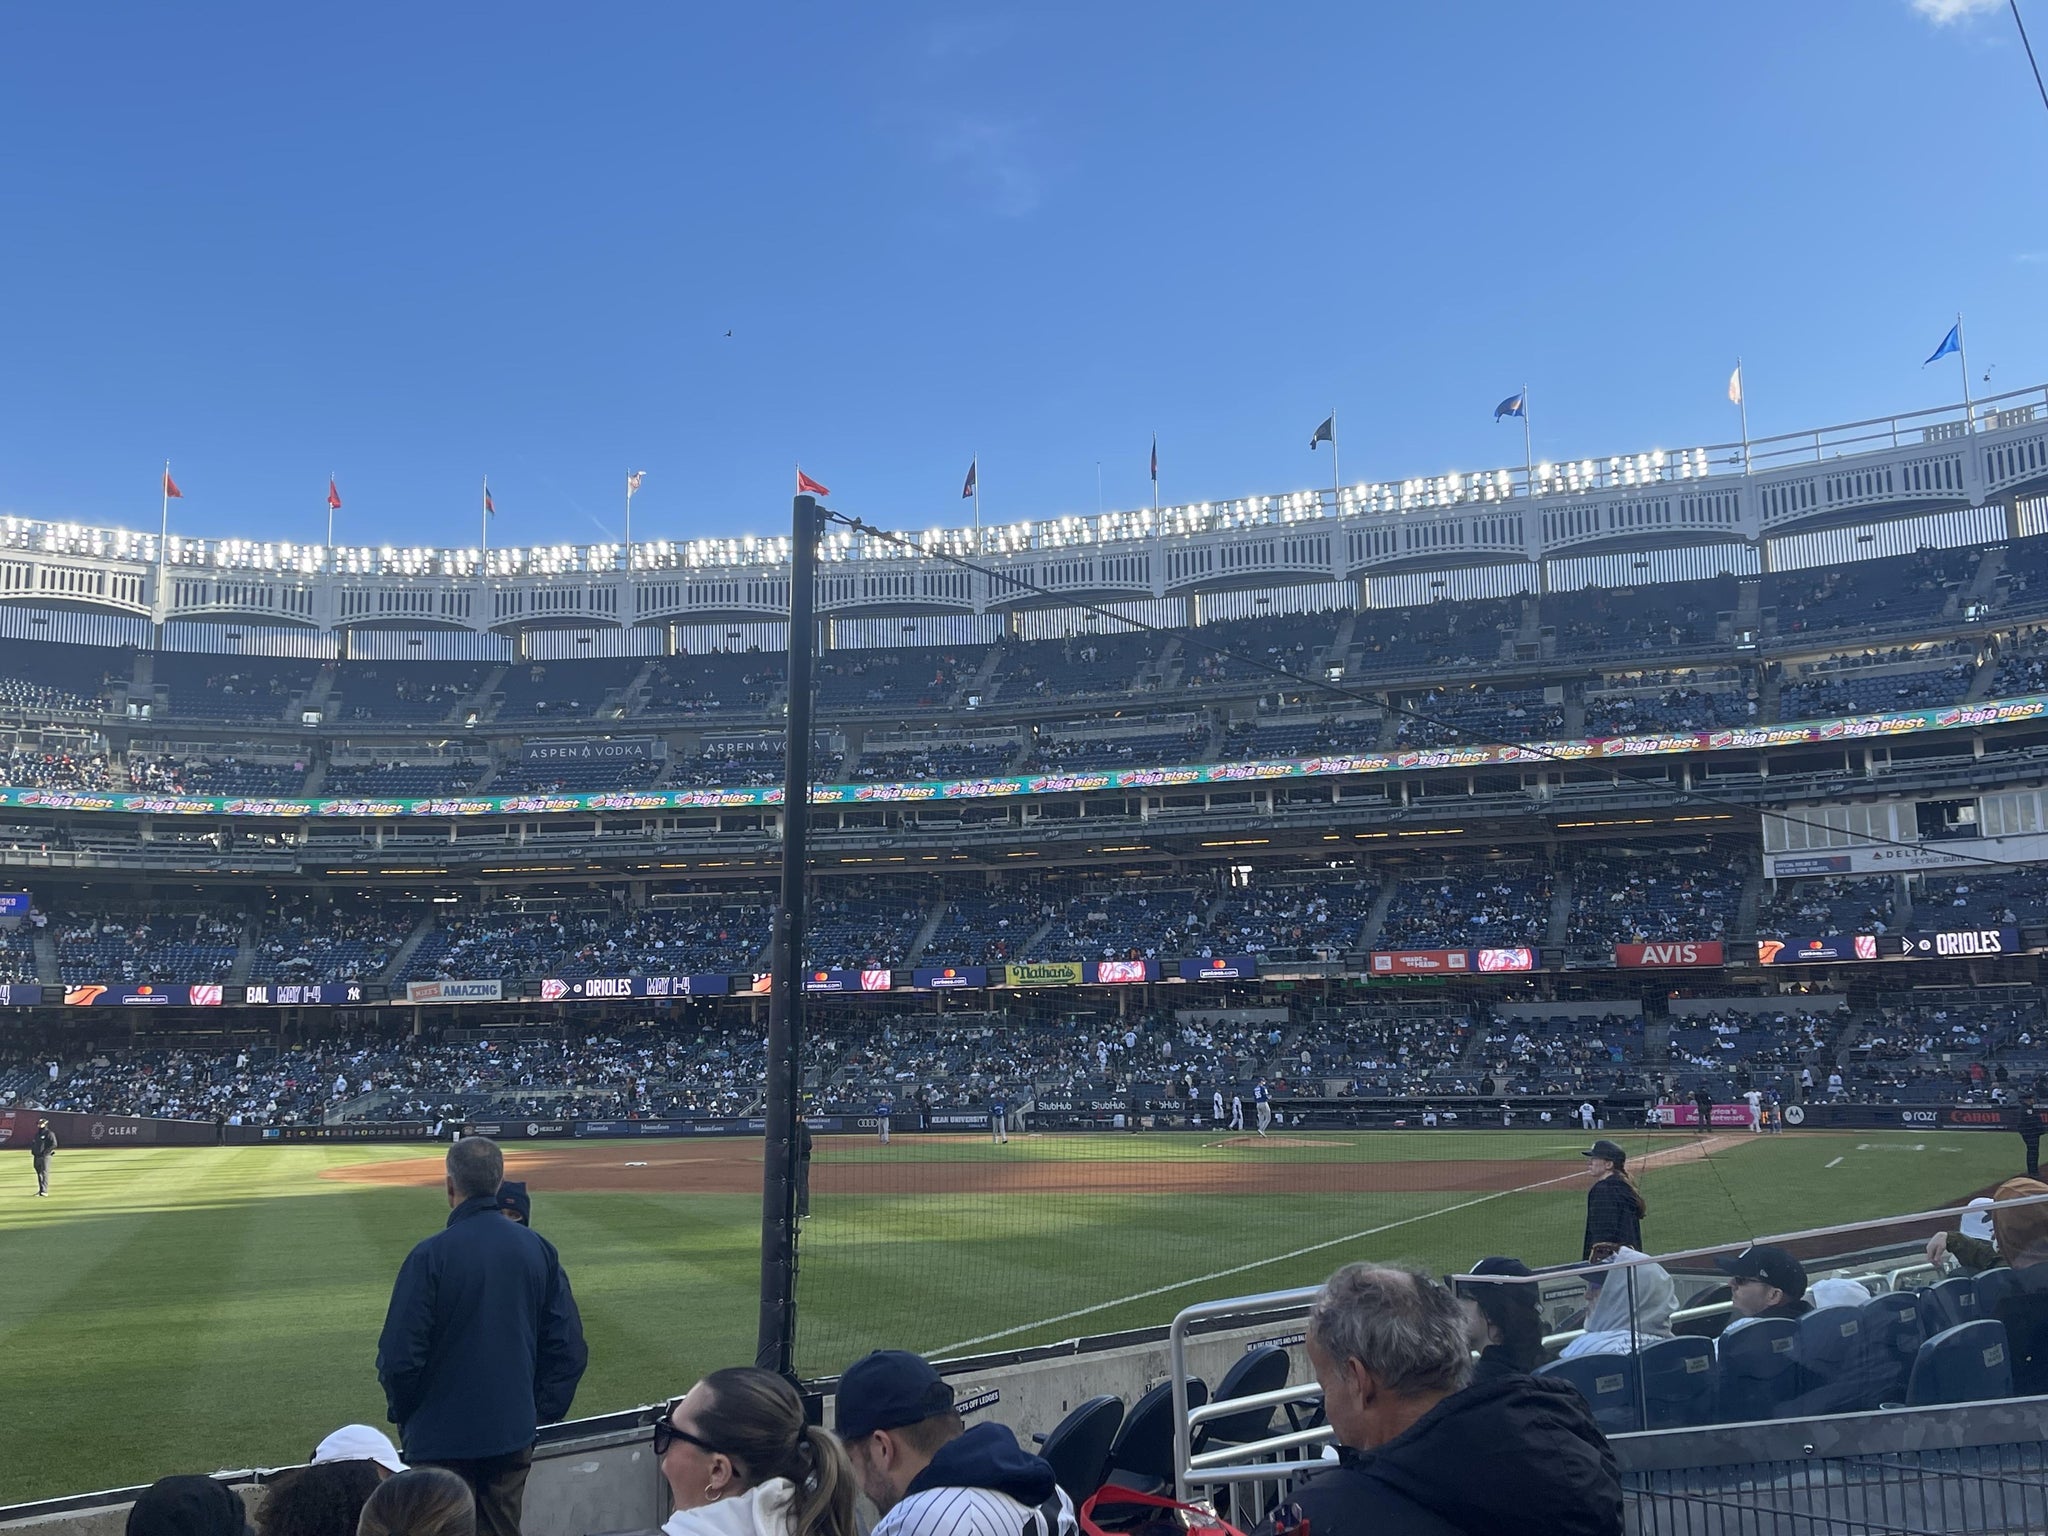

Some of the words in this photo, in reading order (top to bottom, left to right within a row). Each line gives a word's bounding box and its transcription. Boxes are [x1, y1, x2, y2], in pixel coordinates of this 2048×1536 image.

[1959, 710, 1998, 723] Baja
[1998, 702, 2045, 717] Blast
[1843, 723, 1881, 735] Baja
[1880, 717, 1926, 731] Blast
[1732, 733, 1767, 745] Baja
[1767, 729, 1811, 741] Blast
[530, 748, 577, 759] ASPEN
[596, 745, 643, 756] VODKA
[707, 742, 755, 753] ASPEN
[1553, 744, 1594, 756] Blast
[1624, 741, 1658, 754] Baja
[1658, 738, 1701, 750] Blast
[1418, 755, 1450, 766] Baja
[1450, 751, 1491, 763] Blast
[1226, 768, 1256, 779] Baja
[1257, 765, 1293, 776] Blast
[1321, 761, 1350, 773] Baja
[1350, 758, 1390, 769] Blast
[1046, 779, 1074, 790] Baja
[1074, 776, 1110, 787] Blast
[1135, 774, 1164, 785] Baja
[1164, 771, 1200, 782] Blast
[872, 788, 901, 799] Baja
[901, 787, 936, 797] Blast
[960, 785, 988, 795] Baja
[988, 782, 1022, 793] Blast
[39, 796, 72, 806] Baja
[73, 796, 114, 808] Blast
[518, 799, 545, 810] Baja
[545, 799, 580, 809] Blast
[605, 797, 632, 808] Baja
[633, 796, 667, 806] Blast
[692, 795, 721, 805] Baja
[721, 793, 755, 803] Blast
[143, 801, 176, 811] Baja
[176, 802, 215, 811] Blast
[242, 803, 274, 814] Baja
[274, 803, 311, 813] Blast
[337, 804, 368, 814] Baja
[368, 803, 404, 813] Blast
[430, 804, 459, 814] Baja
[460, 802, 493, 812] Blast
[1886, 850, 1928, 859] DELTA
[1936, 931, 2001, 955] ORIOLES
[1641, 945, 1698, 964] AVIS
[1013, 965, 1075, 981] Nathan's
[443, 984, 497, 997] AMAZING
[585, 979, 631, 997] ORIOLES
[647, 978, 669, 995] MAY
[672, 977, 691, 995] 1-4
[246, 987, 269, 1004] BAL
[277, 986, 299, 1003] MAY
[303, 986, 321, 1003] 1-4
[1038, 1102, 1072, 1111] StubHub
[1092, 1101, 1126, 1110] StubHub
[950, 1115, 988, 1123] UNIVERSITY
[1914, 1111, 1937, 1121] razr
[1951, 1110, 2001, 1123] Canon
[108, 1127, 138, 1135] CLEAR
[969, 1398, 979, 1409] OFF
[979, 1391, 999, 1406] LEDGES
